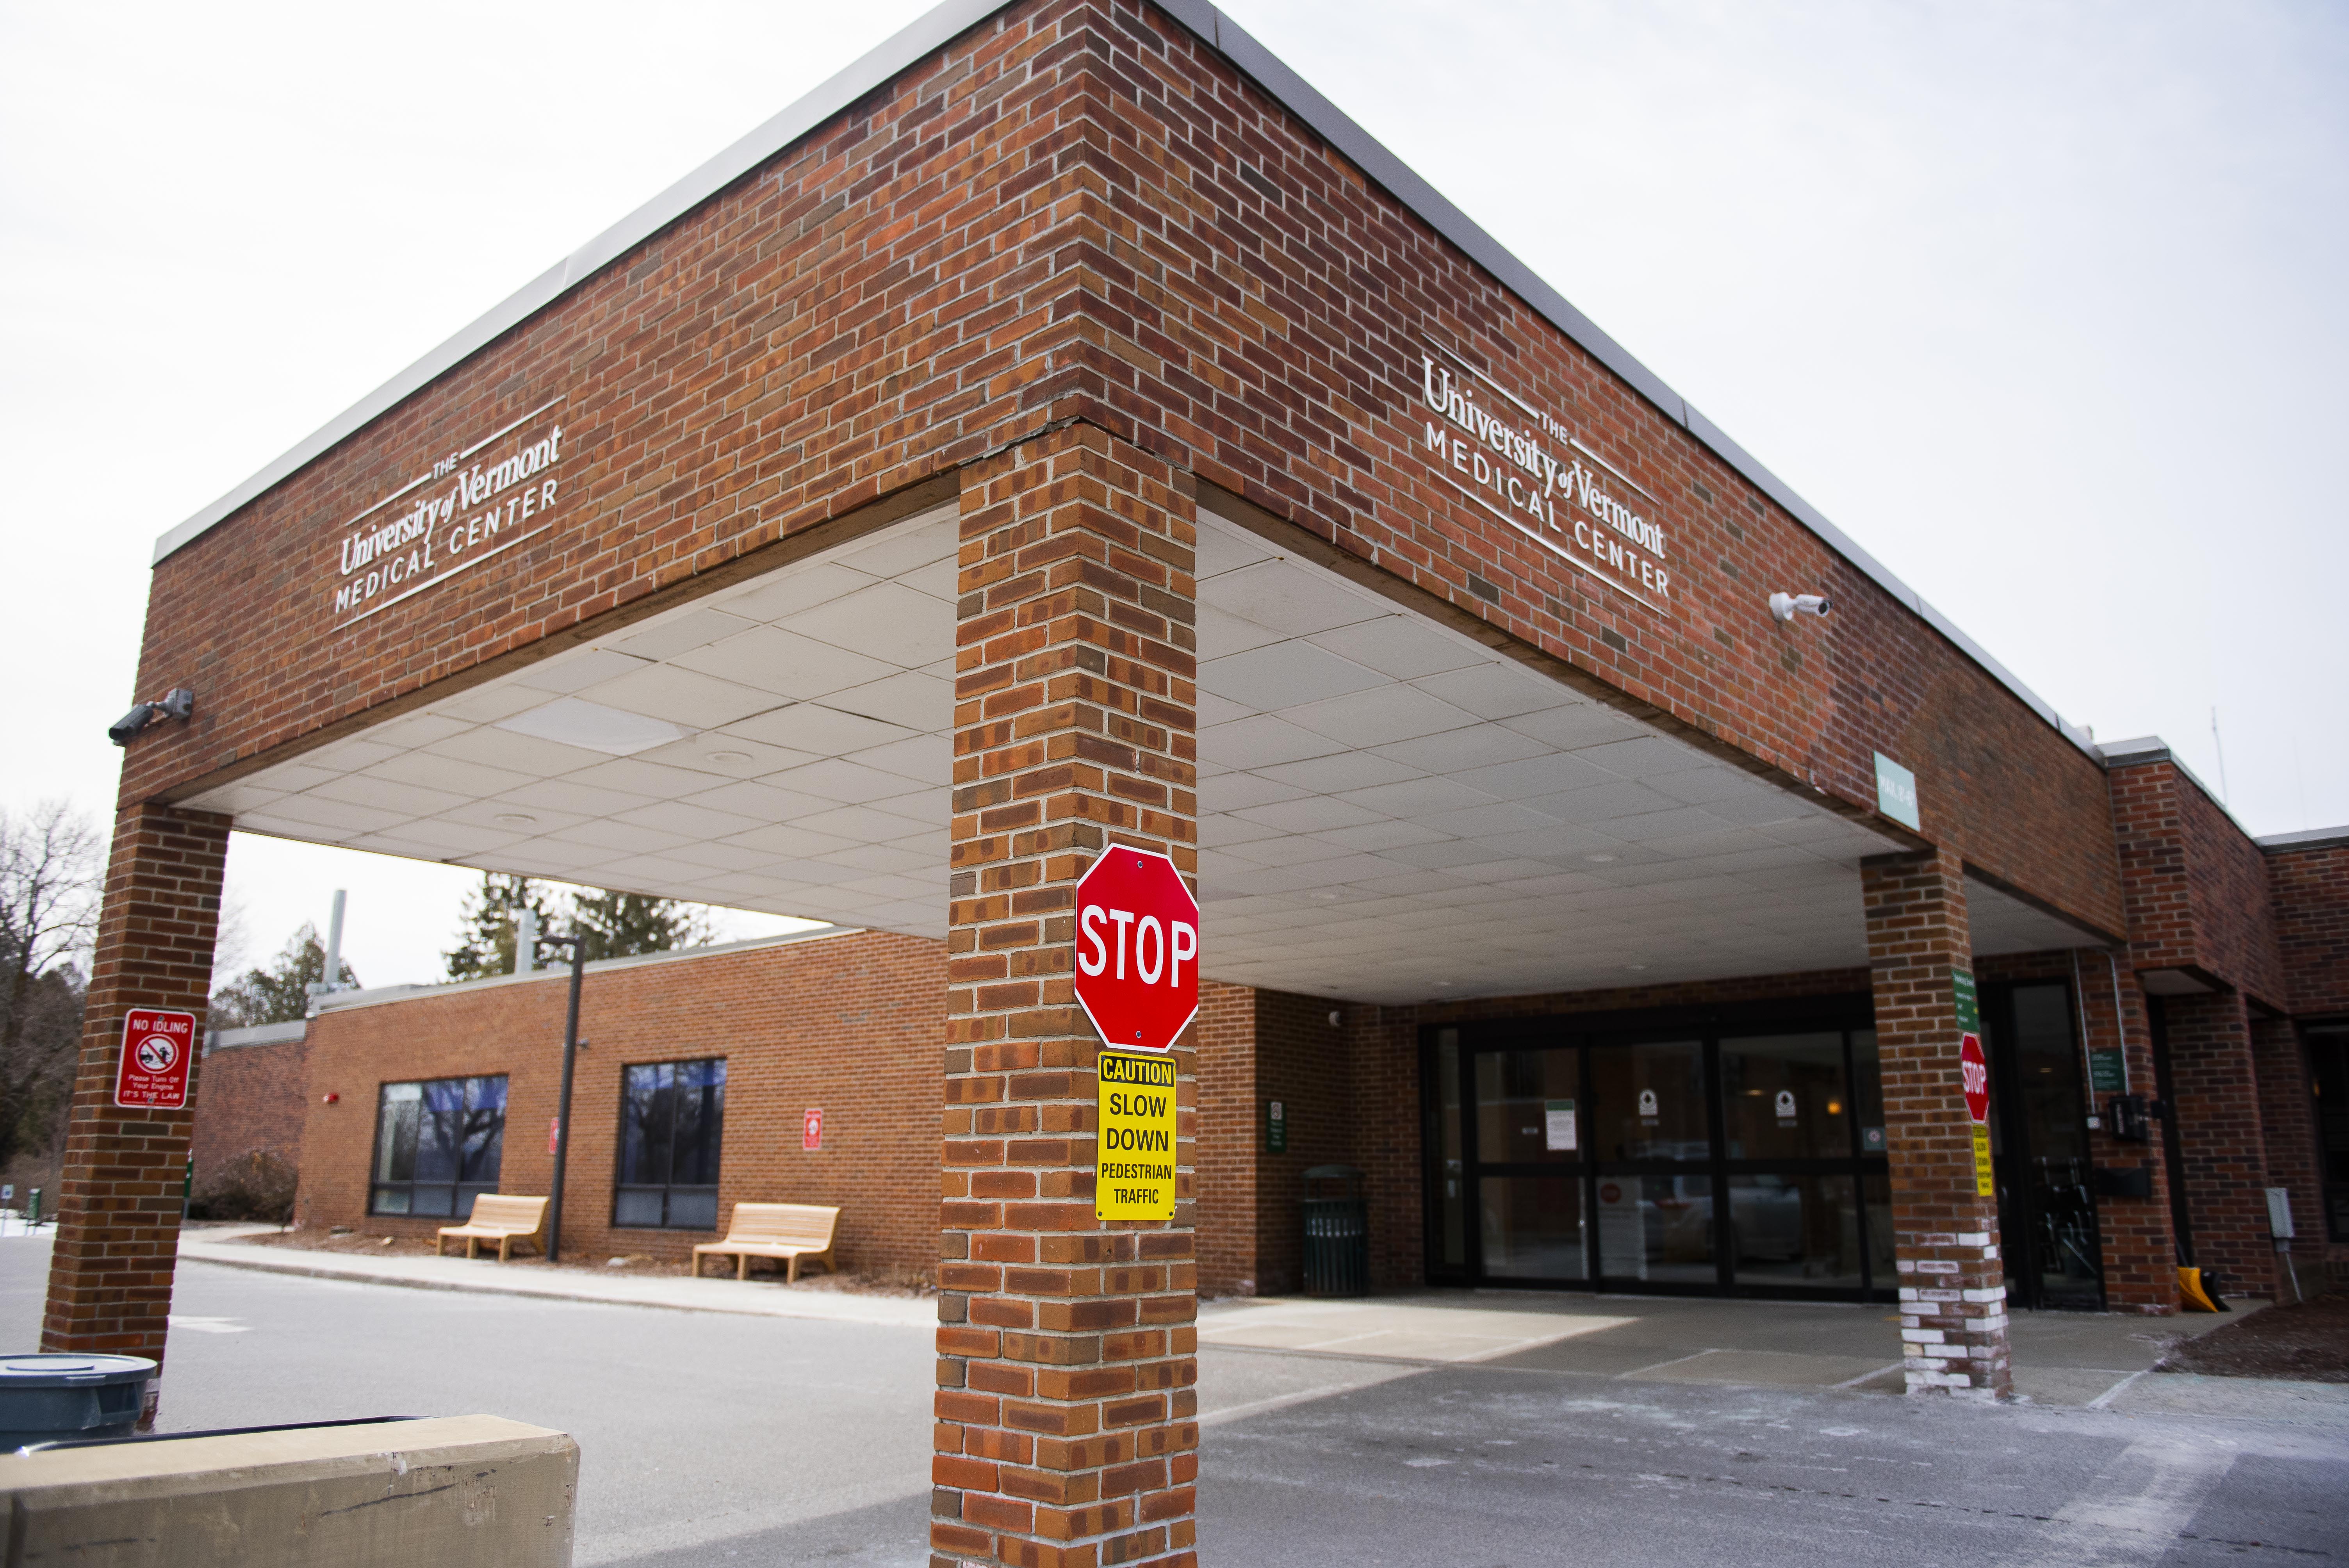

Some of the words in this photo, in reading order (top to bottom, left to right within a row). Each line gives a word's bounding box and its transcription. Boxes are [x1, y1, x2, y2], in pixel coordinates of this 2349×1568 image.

[1540, 412, 1568, 445] THE
[433, 452, 458, 479] THE
[1421, 355, 1558, 499] University
[1558, 469, 1576, 499] of
[1571, 460, 1665, 559] Vermont
[341, 497, 442, 576] University
[441, 486, 458, 523] of
[459, 425, 562, 511] Vermont
[1426, 422, 1561, 533] MEDICAL
[1574, 520, 1669, 598] CENTER
[335, 543, 434, 613] MEDICAL
[449, 479, 557, 555] CENTER
[1078, 905, 1196, 988] STOP
[133, 1019, 149, 1031] NO
[153, 1021, 188, 1034] IDLING
[1103, 1058, 1171, 1084] CAUTION
[1962, 1060, 1986, 1095] STOP
[142, 1091, 159, 1099] THE
[151, 1083, 174, 1091] Engine
[1110, 1093, 1166, 1117] SLOW
[1107, 1128, 1168, 1152] DOWN
[1101, 1163, 1171, 1180] PEDESTRIAN
[1114, 1188, 1158, 1204] TRAFFIC
